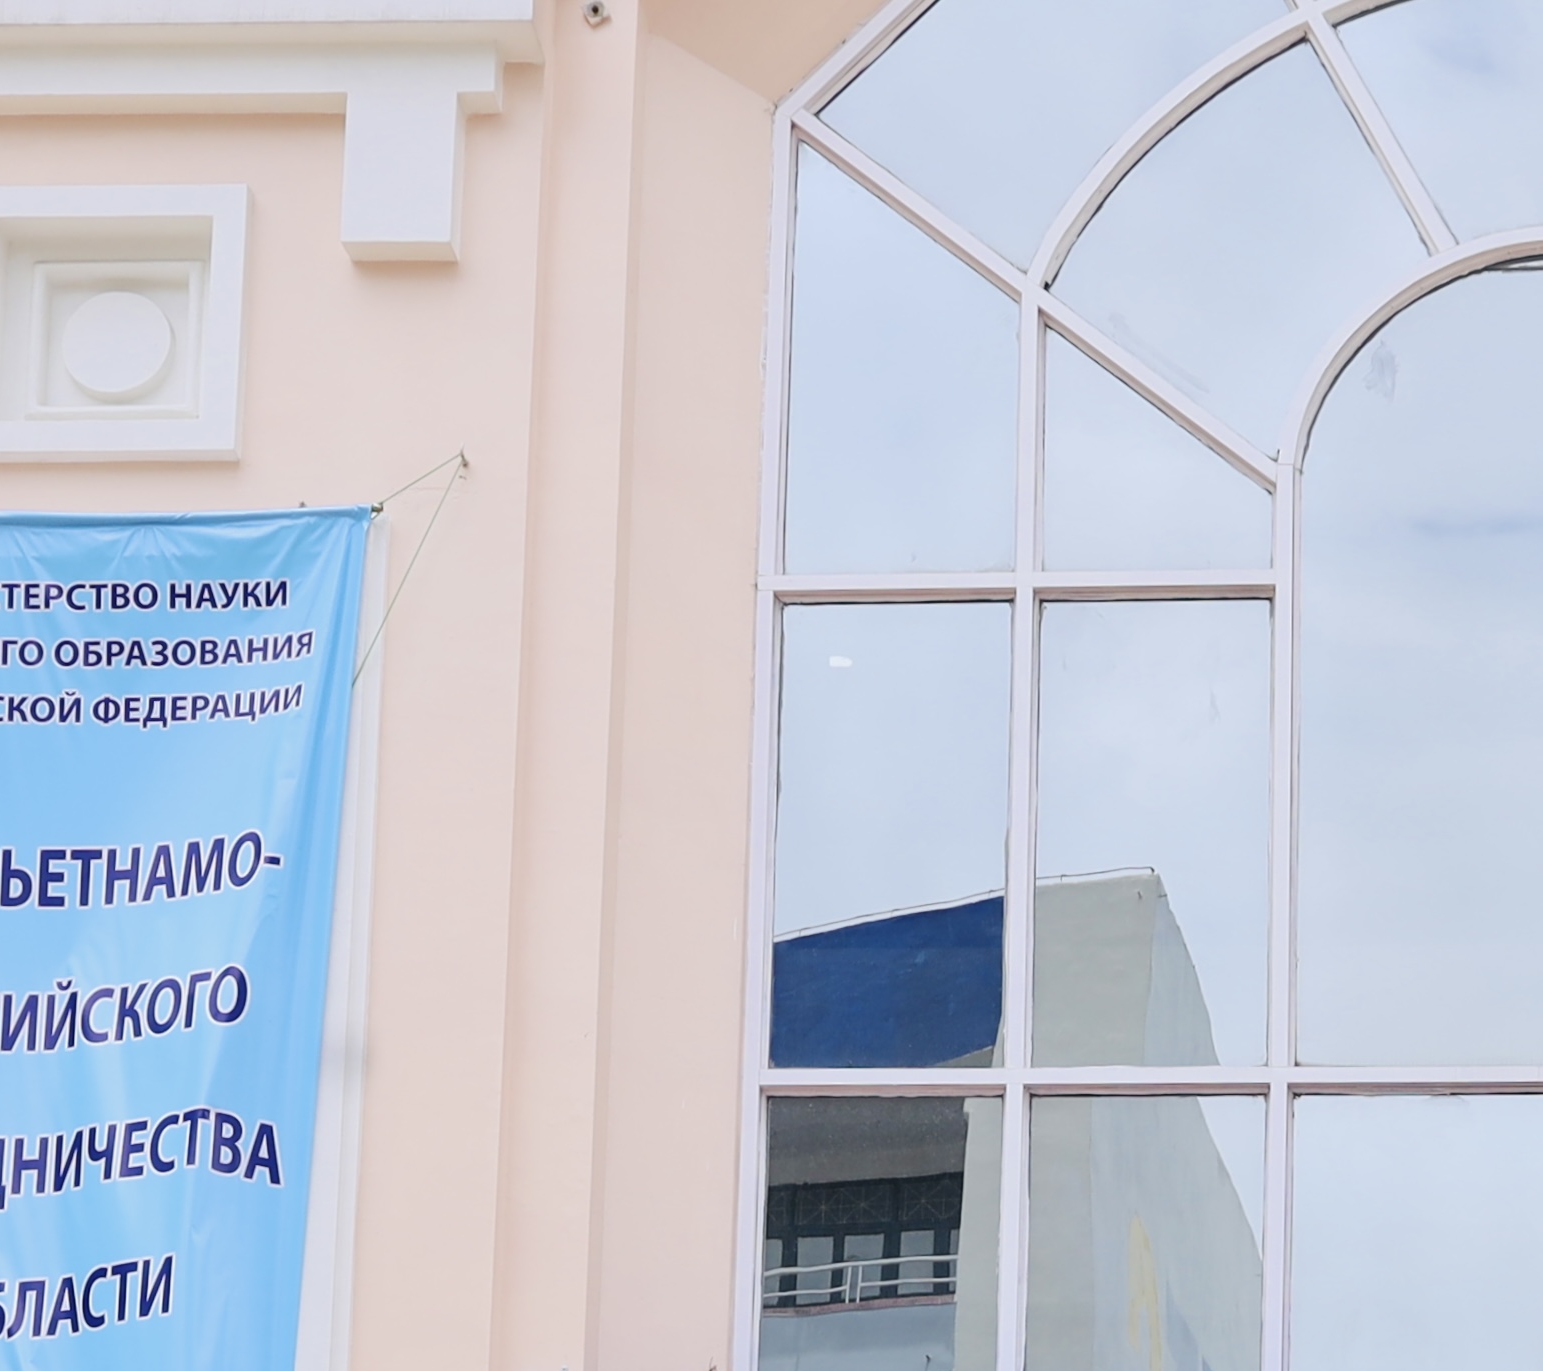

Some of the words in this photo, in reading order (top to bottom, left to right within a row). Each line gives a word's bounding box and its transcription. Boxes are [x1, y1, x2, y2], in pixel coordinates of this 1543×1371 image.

[168, 579, 288, 610] НАУКИ
[53, 631, 314, 668] ОБРАЗОВАНИЯ
[91, 683, 303, 730] ФЕДЕРАЦИИ
